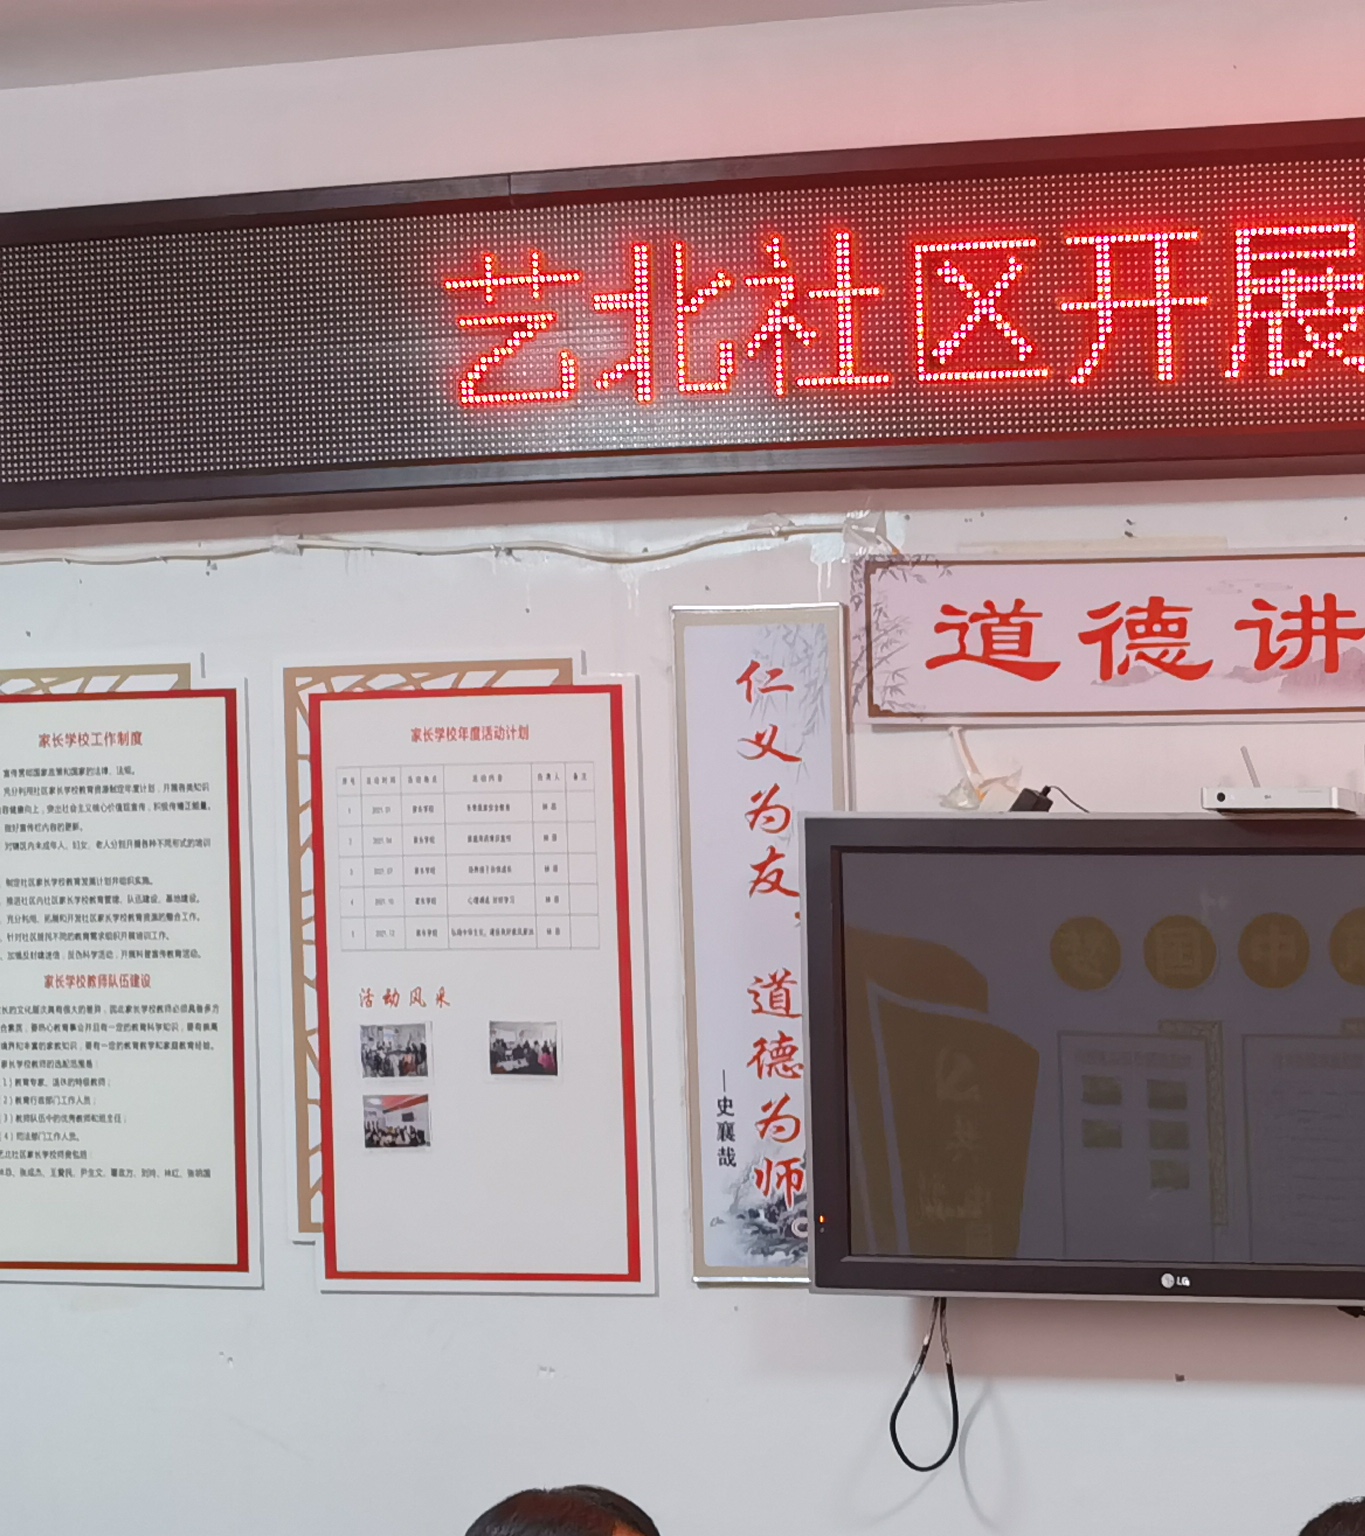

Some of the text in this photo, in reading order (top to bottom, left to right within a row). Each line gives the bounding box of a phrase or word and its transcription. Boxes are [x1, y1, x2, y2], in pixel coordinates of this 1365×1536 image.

[38, 731, 143, 748] 家长学校工作制度
[411, 725, 529, 743] 家长学校年度活动计划
[44, 973, 152, 989] 家长学校教师队伍建设
[358, 986, 451, 1010] 活动风采
[1176, 1276, 1190, 1286] LG
